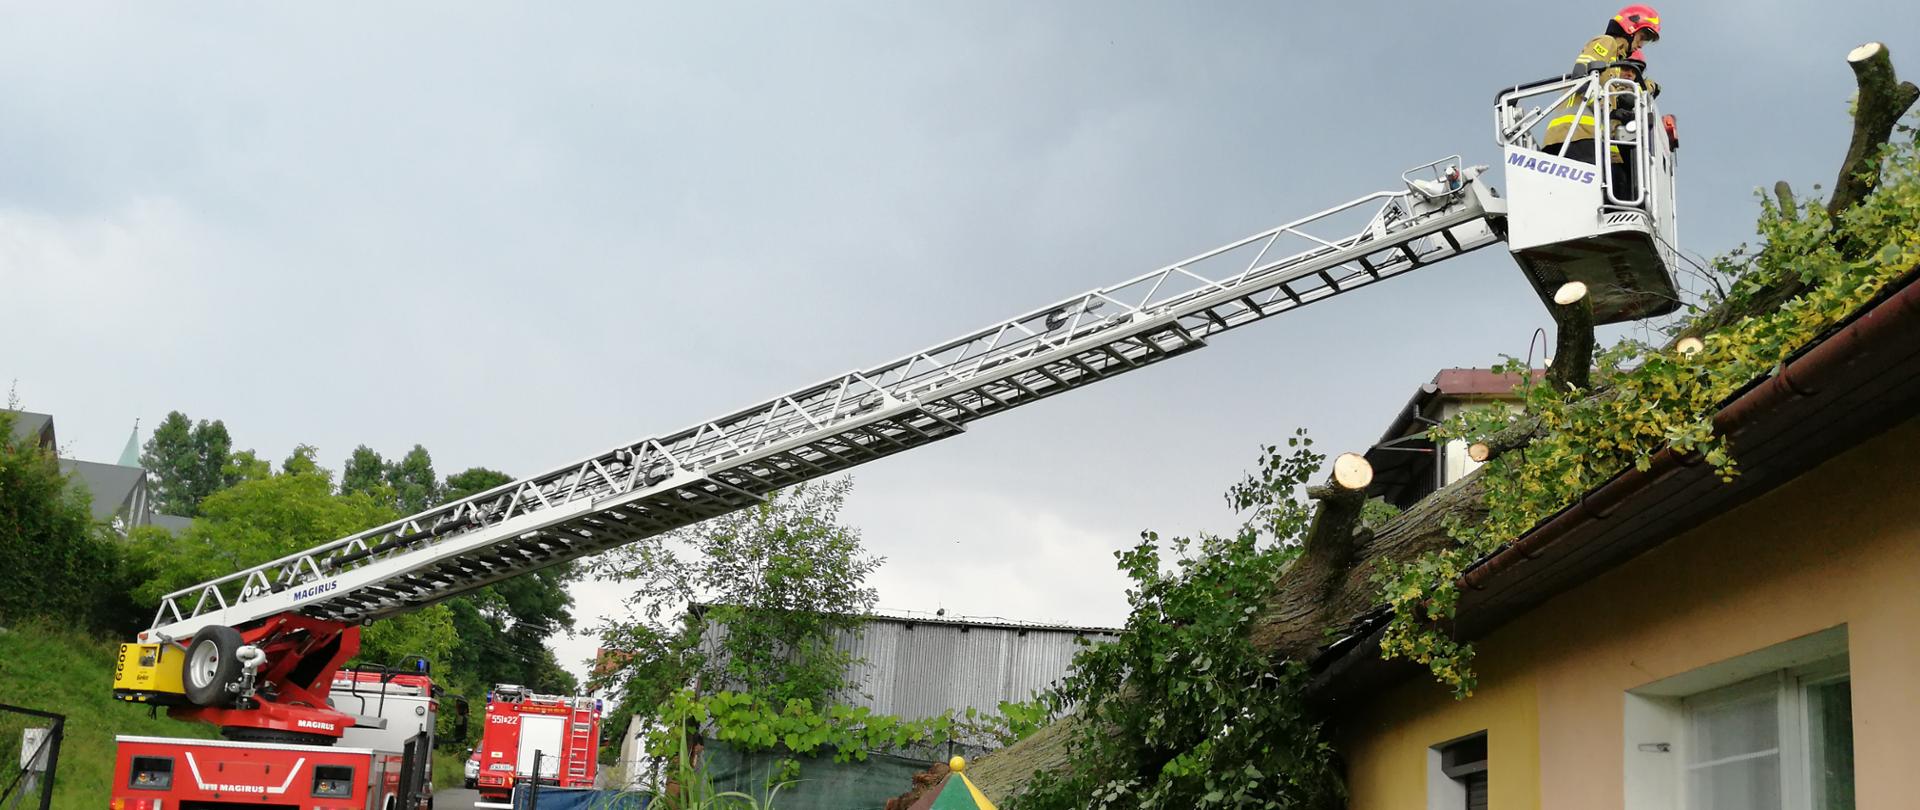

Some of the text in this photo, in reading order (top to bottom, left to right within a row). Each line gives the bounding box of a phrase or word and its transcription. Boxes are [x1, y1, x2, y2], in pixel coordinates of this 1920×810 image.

[1507, 152, 1595, 185] MAGIRUS
[293, 580, 337, 602] MAGIRUS
[115, 644, 128, 681] 6600
[297, 719, 335, 731] MAGIRUS
[219, 783, 265, 793] MAGIRUS
